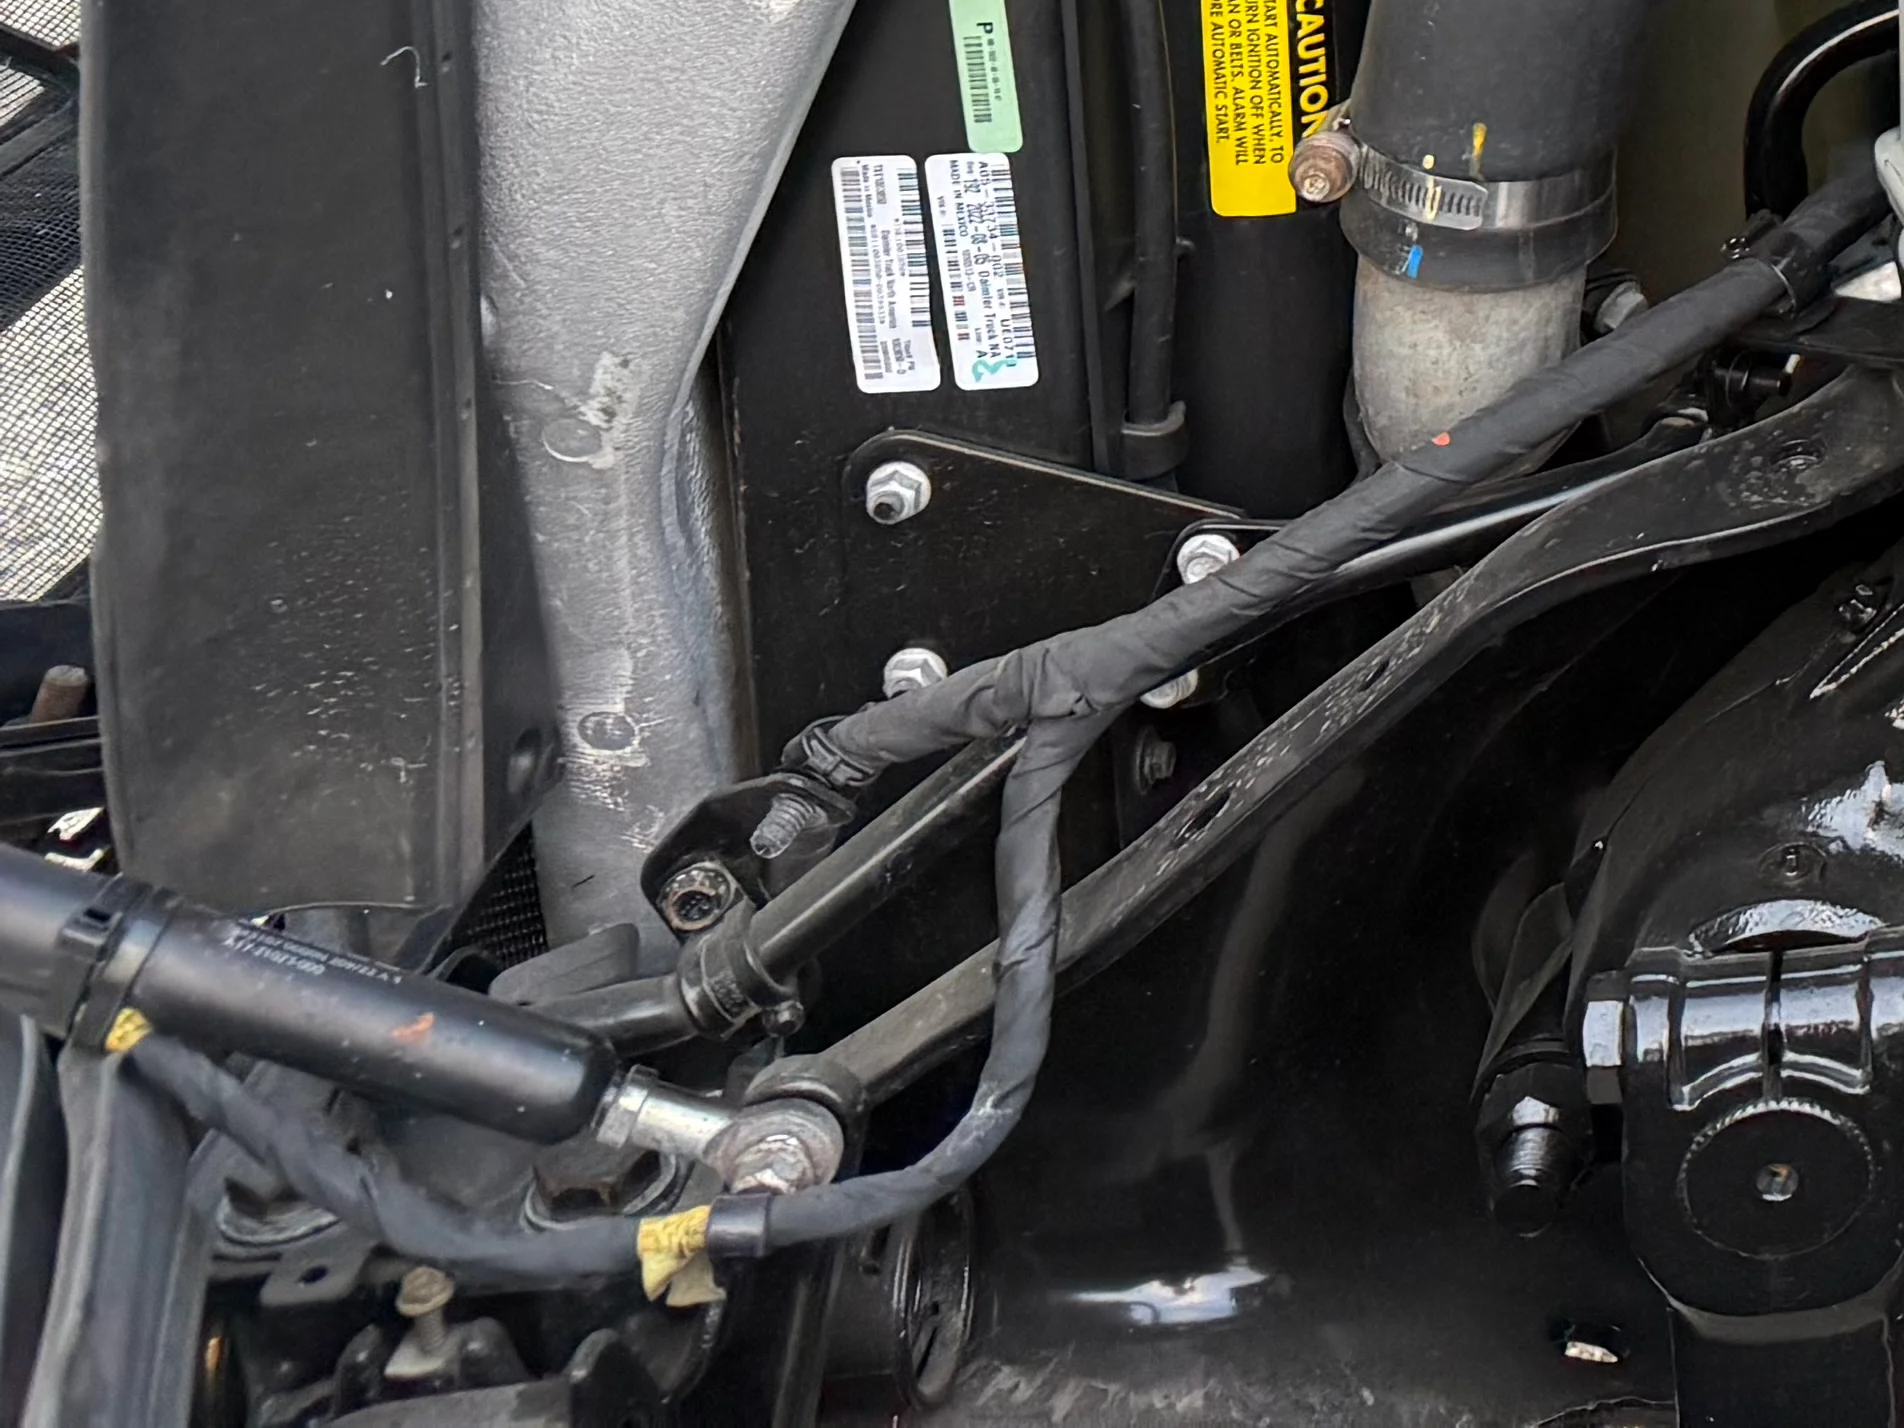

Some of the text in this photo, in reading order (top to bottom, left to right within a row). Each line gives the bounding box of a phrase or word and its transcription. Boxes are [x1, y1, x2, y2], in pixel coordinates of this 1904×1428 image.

[976, 21, 995, 36] P
[1229, 17, 1241, 37] OR
[1211, 22, 1228, 100] AUTOMATIC
[1246, 28, 1262, 87] IGNITION
[1232, 88, 1247, 137] ALARM
[1251, 94, 1264, 117] OFF
[1235, 137, 1250, 166] WILL
[1252, 118, 1266, 165] WHEN
[1271, 144, 1284, 164] TO
[949, 159, 961, 185] MADE
[953, 189, 963, 200] IN
[955, 202, 970, 238] MEXICO
[976, 348, 989, 360] A
